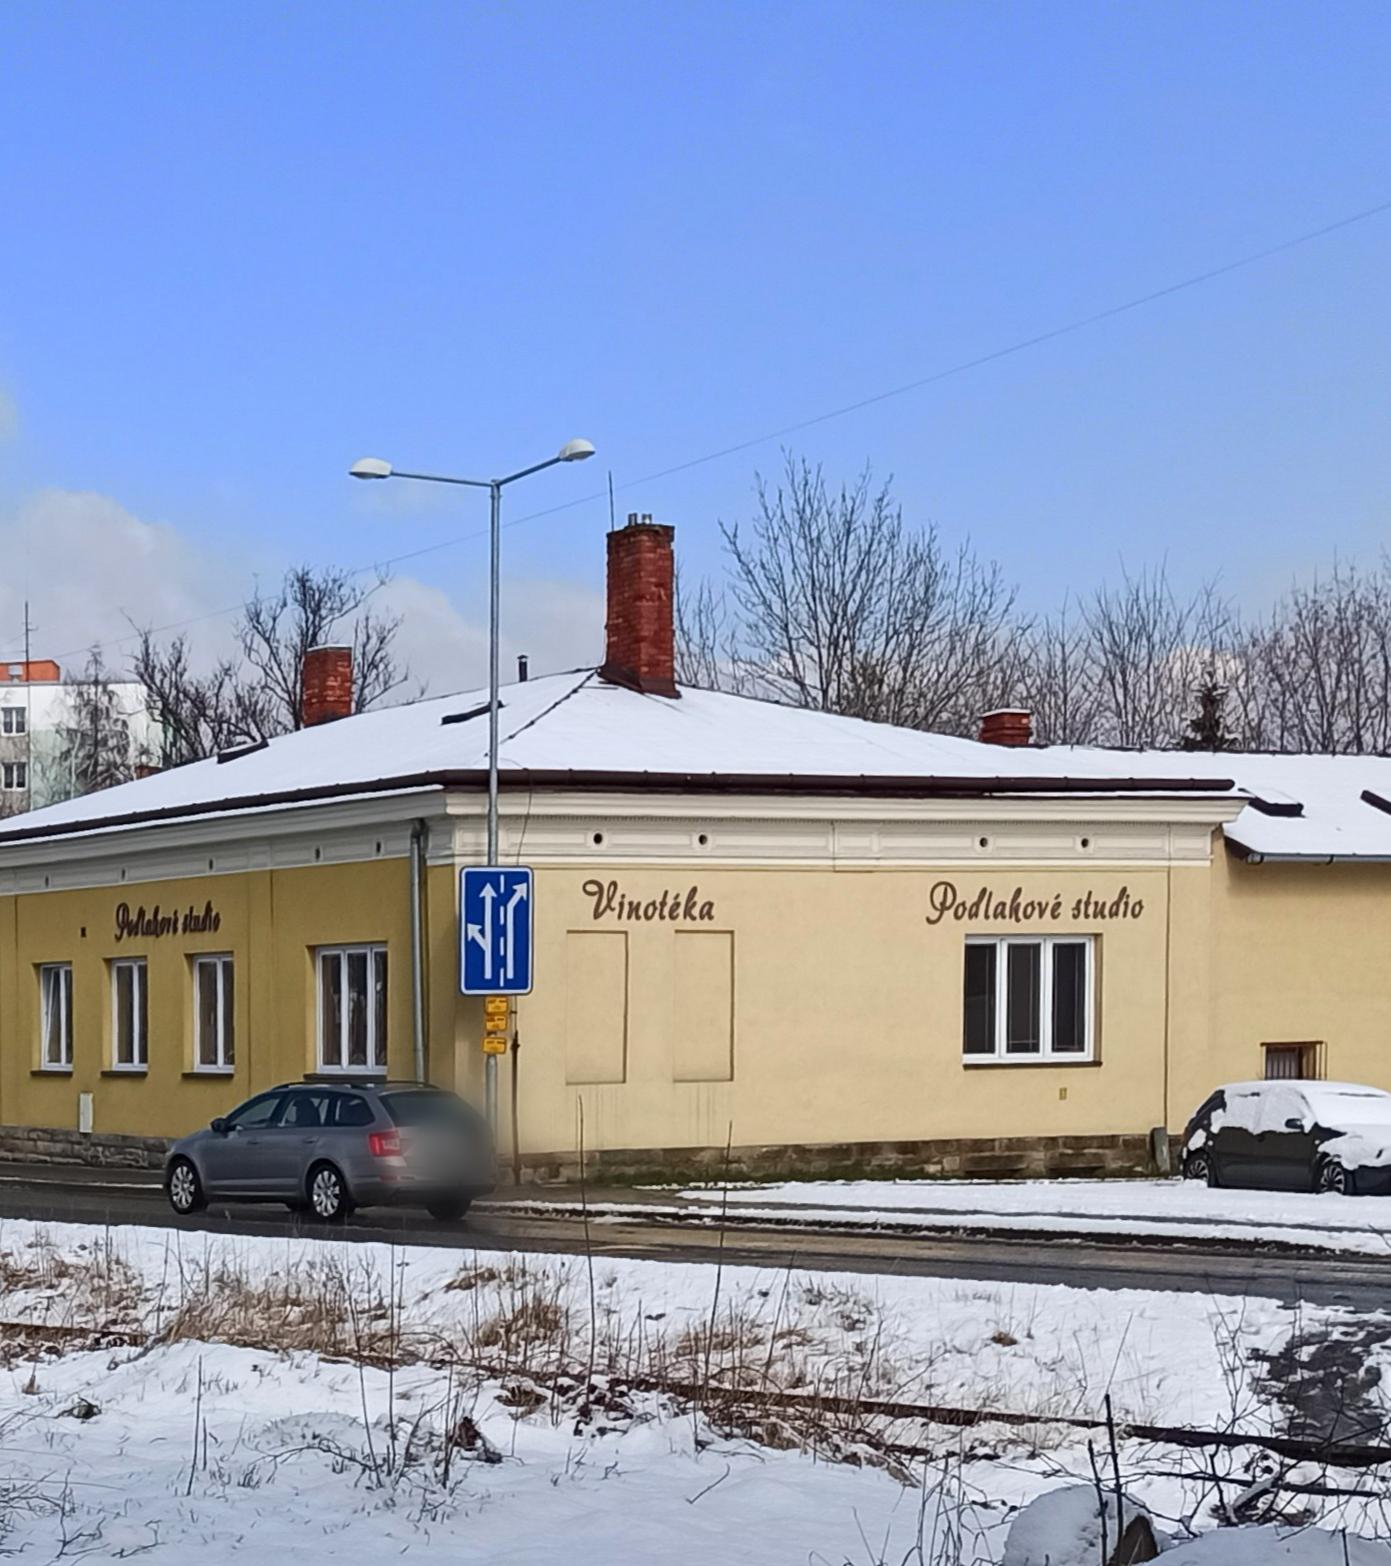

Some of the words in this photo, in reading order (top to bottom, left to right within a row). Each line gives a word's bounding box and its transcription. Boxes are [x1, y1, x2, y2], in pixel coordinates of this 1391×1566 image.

[182, 900, 221, 934] studio
[582, 879, 715, 921] Vinotéka
[926, 881, 1062, 925] Podlahové
[1071, 886, 1144, 920] studio
